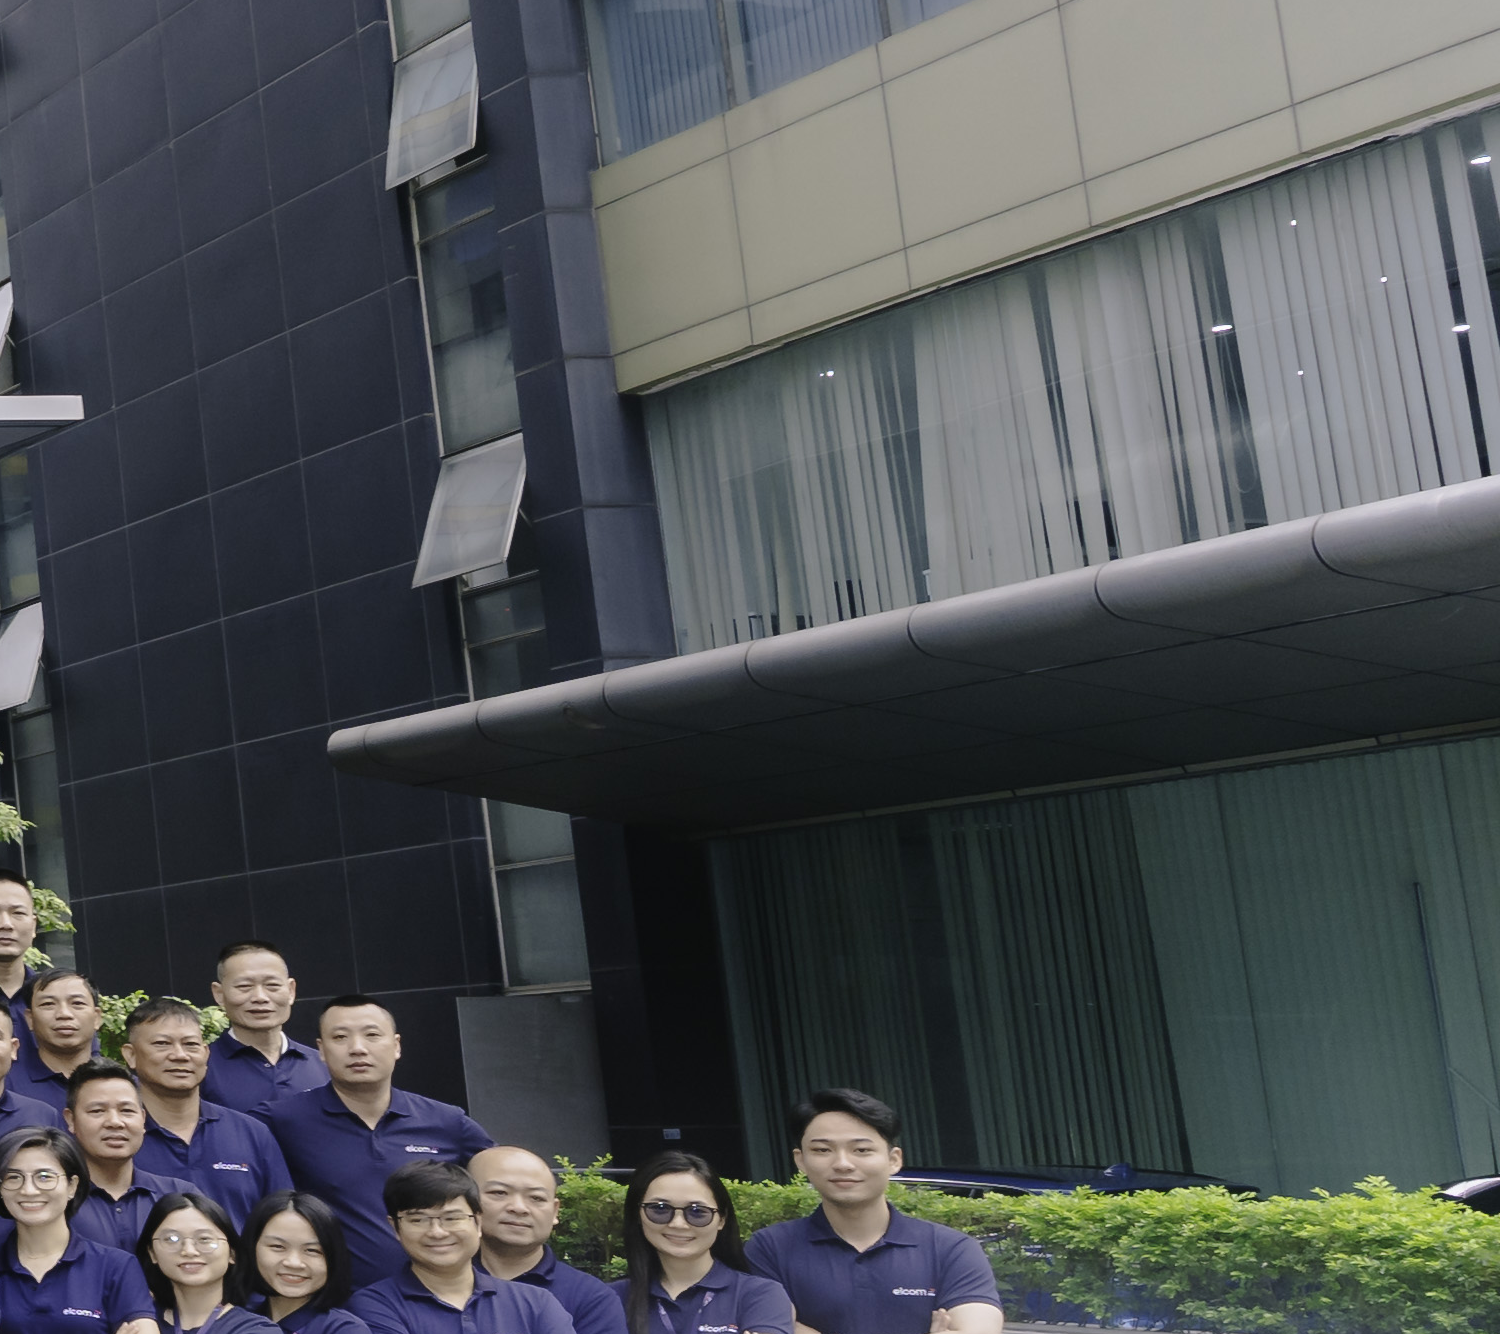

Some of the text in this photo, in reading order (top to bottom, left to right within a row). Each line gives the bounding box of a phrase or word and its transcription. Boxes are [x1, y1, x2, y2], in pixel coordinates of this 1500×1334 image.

[404, 1144, 431, 1153] elcom
[212, 1162, 242, 1171] elcom
[892, 1286, 927, 1297] elcom
[62, 1307, 93, 1317] elcom
[697, 1324, 728, 1333] elcom
